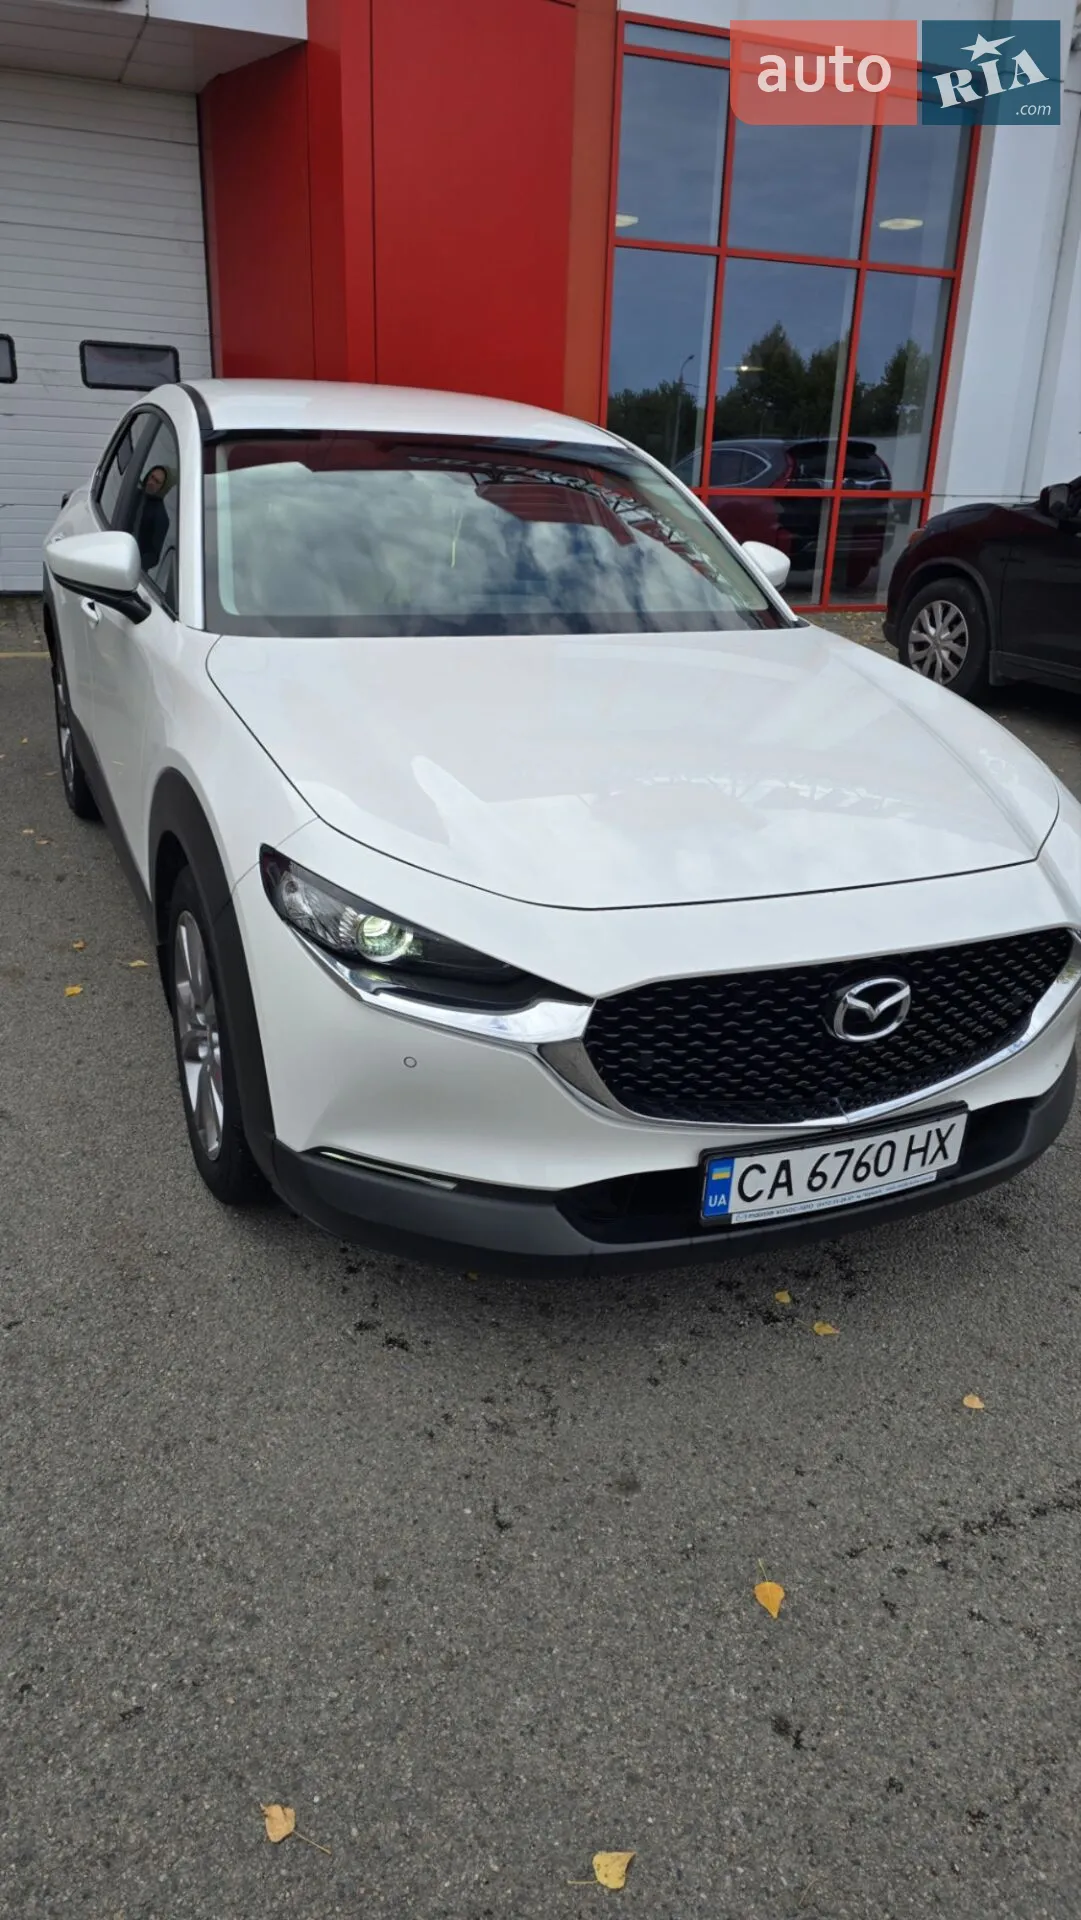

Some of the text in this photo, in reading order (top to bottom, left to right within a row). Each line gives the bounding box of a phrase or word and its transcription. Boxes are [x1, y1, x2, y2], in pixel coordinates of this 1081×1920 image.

[737, 1123, 956, 1203] CA 6760 HX
[708, 1194, 727, 1208] UA
